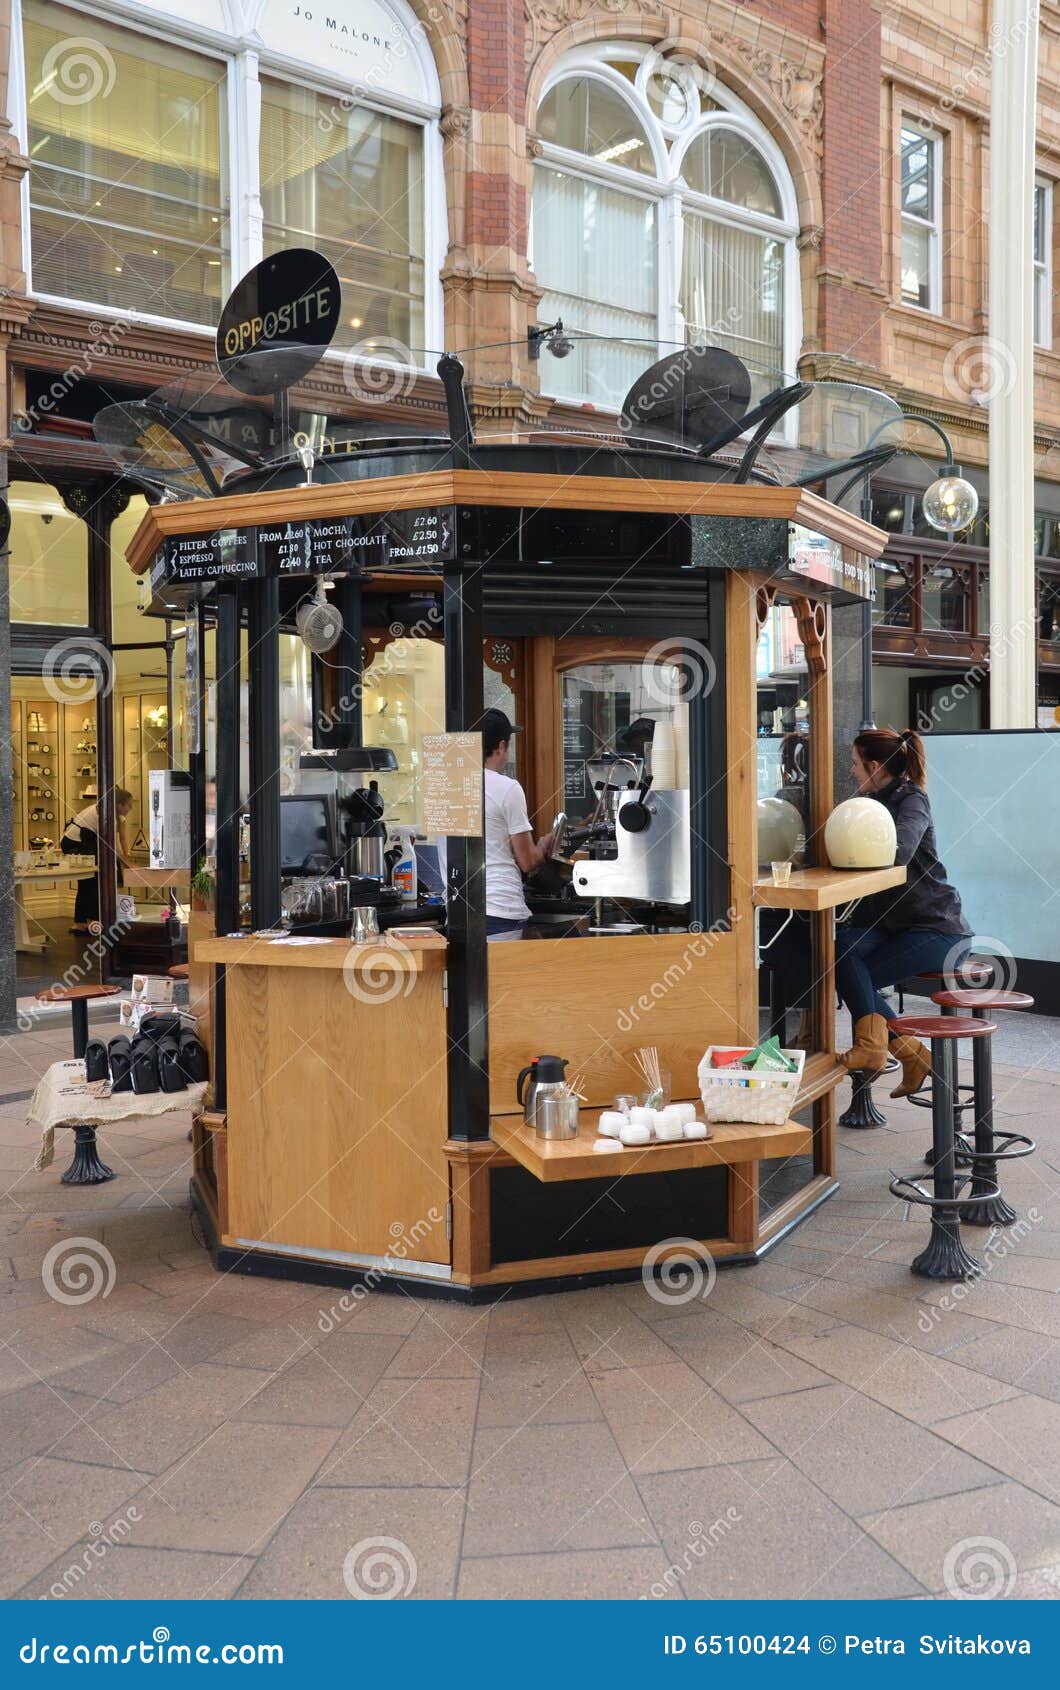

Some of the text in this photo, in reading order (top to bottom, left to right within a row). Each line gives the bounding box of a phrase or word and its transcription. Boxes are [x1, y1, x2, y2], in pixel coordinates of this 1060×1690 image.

[294, 6, 313, 21] JO
[326, 17, 391, 50] MALONE
[225, 286, 331, 355] OPPOSITE
[313, 524, 348, 538] MOCHA
[179, 540, 208, 551] FILTER
[210, 535, 248, 548] COFFEES
[259, 532, 282, 543] FROM
[313, 541, 333, 551] HOT
[335, 535, 387, 549] CHOCOLATE
[179, 552, 214, 564] ESPRESSO
[314, 554, 333, 565] TEA
[389, 547, 414, 557] FROM
